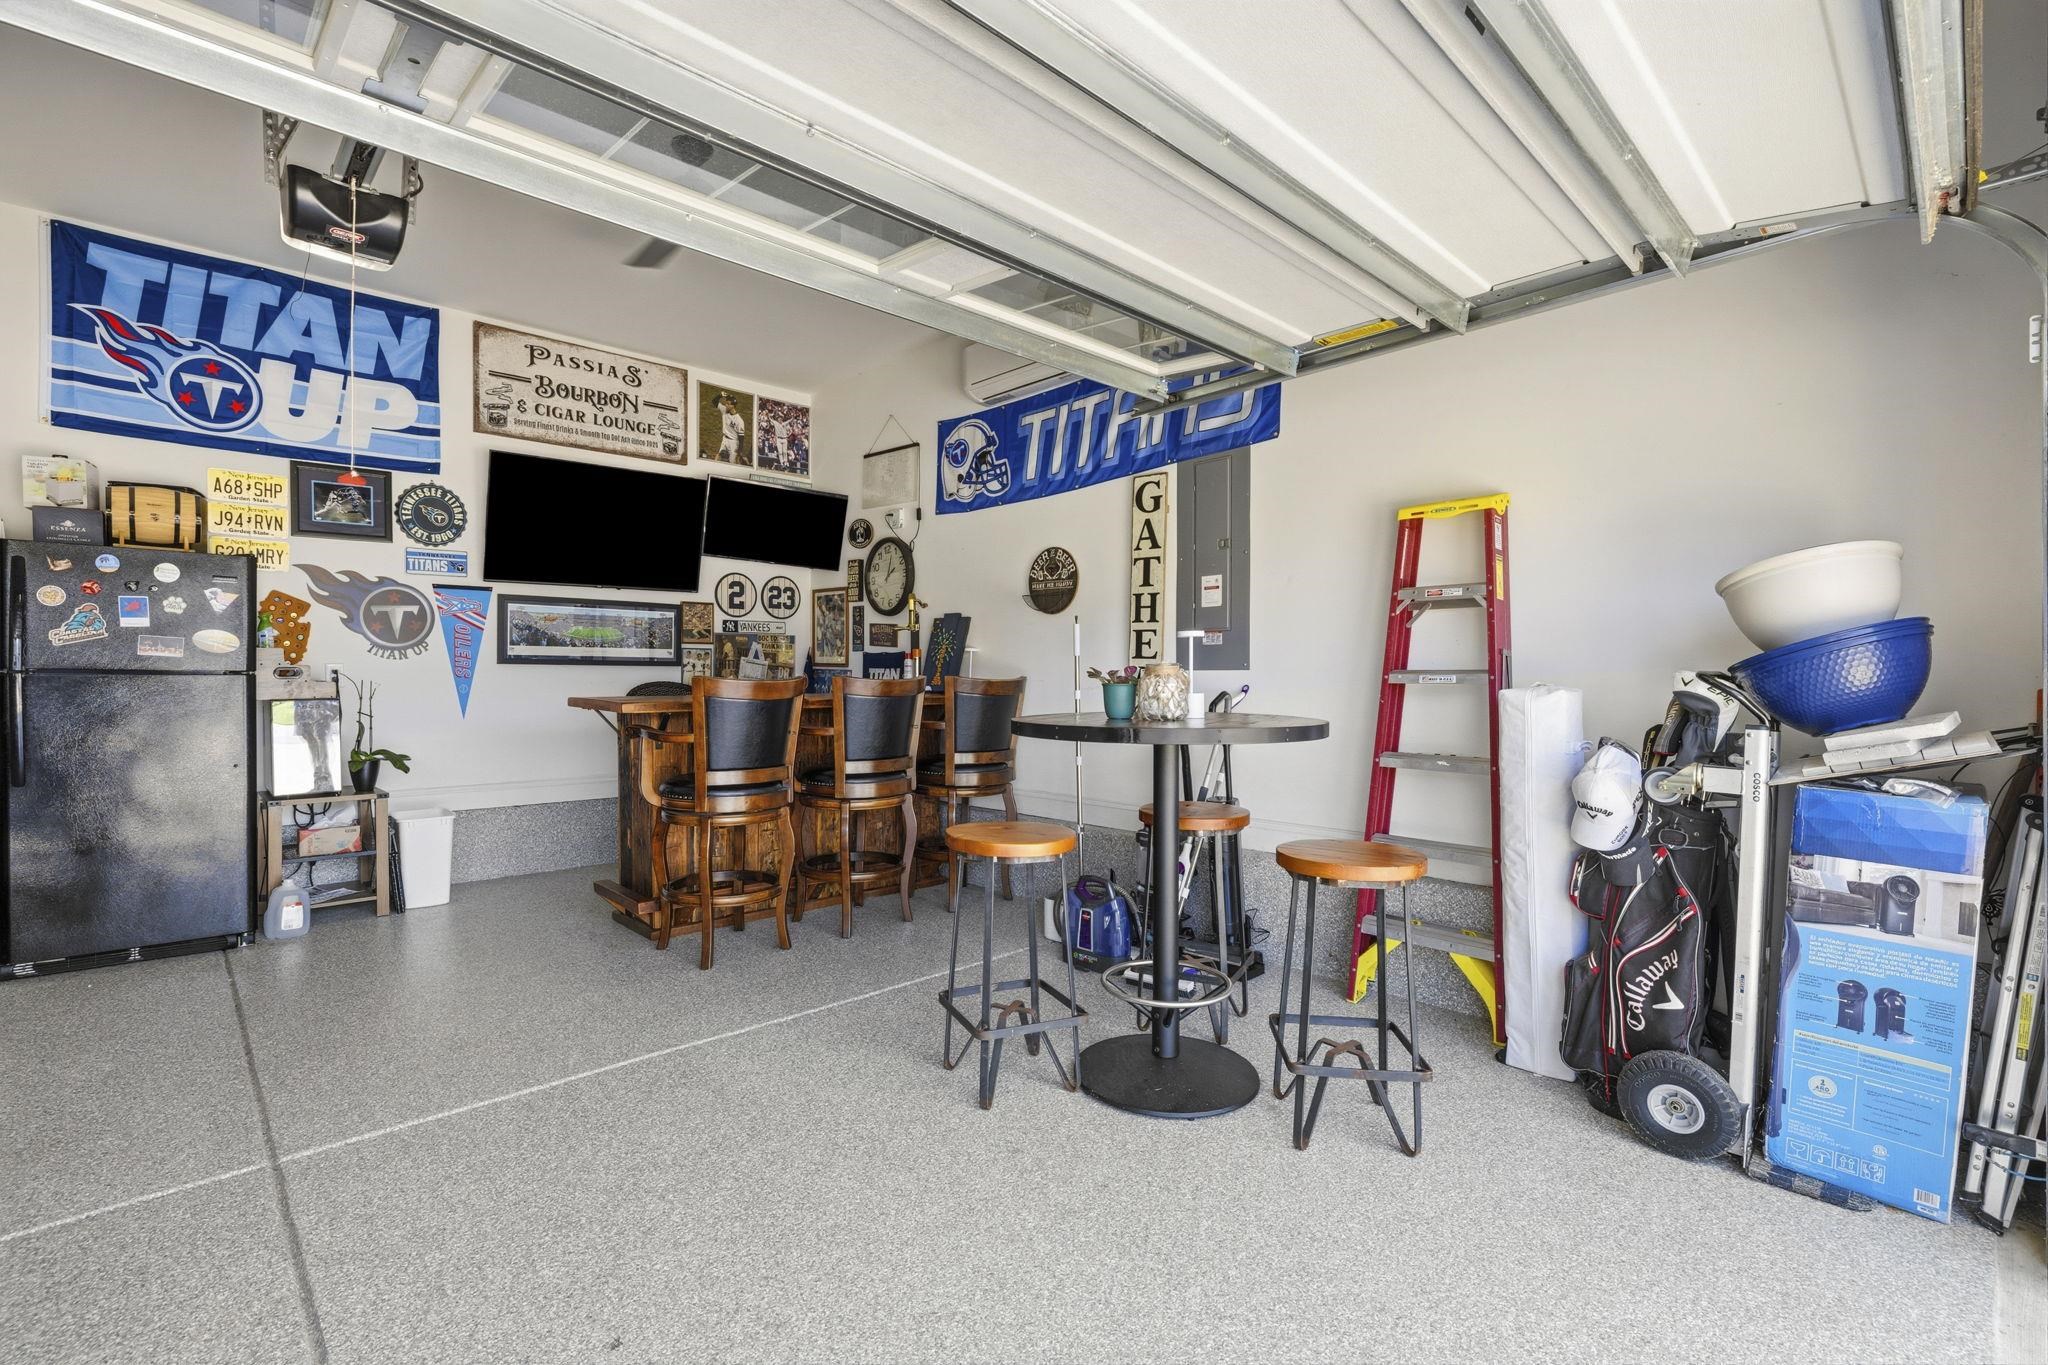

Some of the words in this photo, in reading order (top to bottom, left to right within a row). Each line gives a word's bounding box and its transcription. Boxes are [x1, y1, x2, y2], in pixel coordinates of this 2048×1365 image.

[86, 241, 431, 381] TITAN
[256, 357, 419, 449] UP
[534, 374, 640, 415] BOURBON
[517, 399, 527, 413] &
[534, 403, 586, 424] CIGAR
[593, 413, 656, 436] LOUNGE
[214, 477, 243, 495] A68
[254, 481, 283, 499] SHP
[401, 487, 443, 520] TENNESSEE
[444, 493, 464, 526] TITANS
[214, 511, 243, 528] J94
[254, 514, 283, 532] RVN
[410, 526, 429, 541] EST.
[256, 547, 284, 565] MRY
[407, 558, 448, 573] TITANS
[1030, 551, 1049, 579] DEER
[1056, 549, 1076, 575] BEER
[1131, 480, 1163, 679] GATHE
[728, 580, 745, 609] 2
[768, 585, 796, 610] 23
[739, 622, 771, 632] YANKEES
[367, 642, 409, 660] TITAN
[411, 641, 430, 656] UP
[454, 623, 472, 679] OILERS
[1707, 685, 1735, 706] EPIC
[1752, 772, 1761, 803] COSCO
[1577, 800, 1614, 817] Callaway
[1623, 949, 1679, 1031] Callaway
